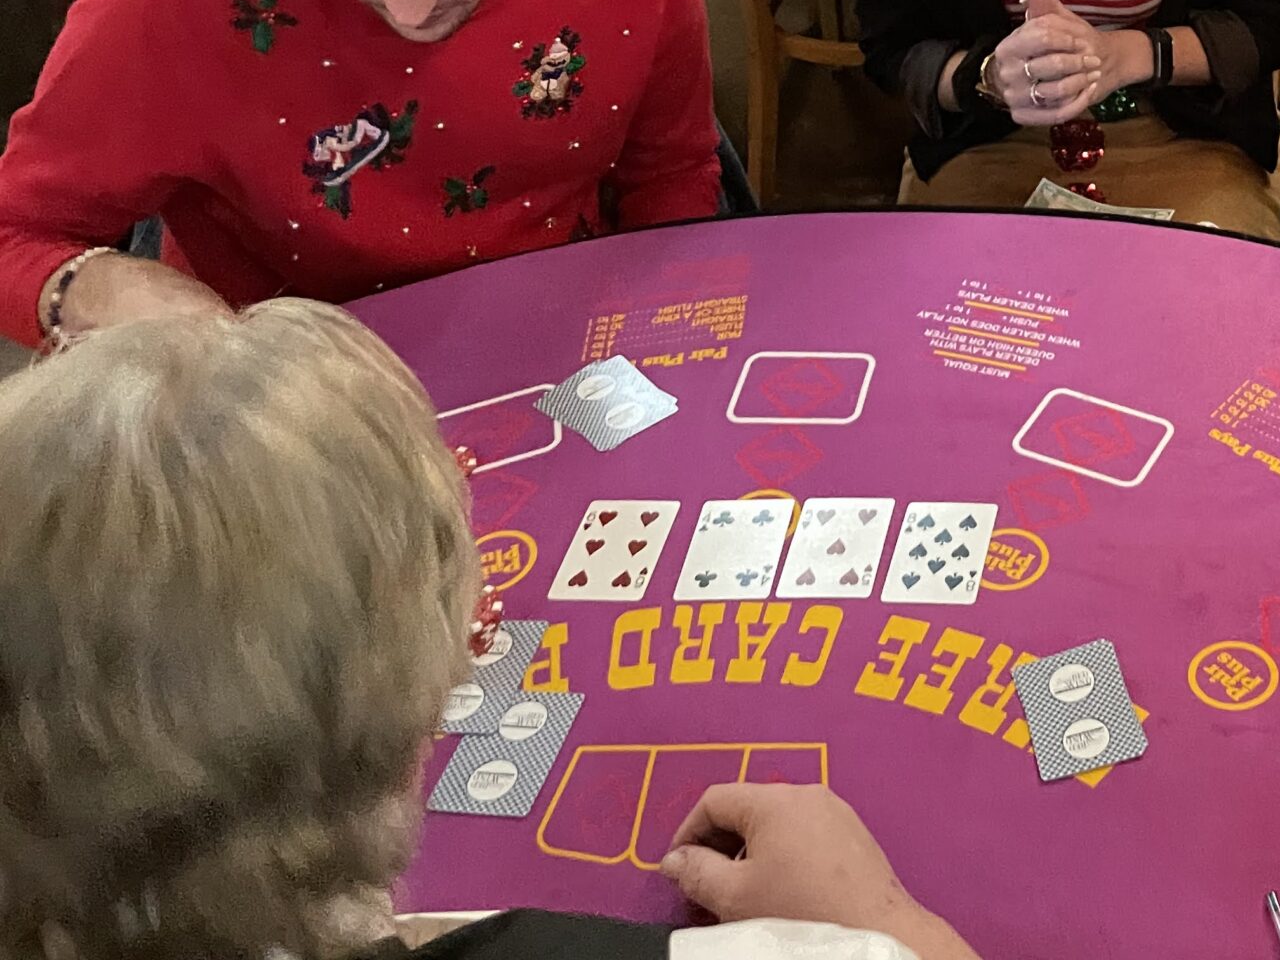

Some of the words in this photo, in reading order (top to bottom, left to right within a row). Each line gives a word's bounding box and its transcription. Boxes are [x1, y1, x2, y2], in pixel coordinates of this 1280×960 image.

[958, 289, 990, 302] PLAYS
[993, 296, 1035, 310] DEALER
[916, 309, 944, 321] PLAY
[1038, 304, 1068, 316] WHEN
[946, 315, 968, 326] NOT
[971, 320, 1000, 331] DOES
[1009, 316, 1039, 327] PUSH
[924, 328, 966, 342] BETTER
[1002, 325, 1045, 340] DEALER
[928, 337, 957, 349] WITH
[968, 336, 984, 345] OR
[986, 340, 1013, 351] HIGH
[1047, 335, 1080, 347] WHEN
[688, 346, 727, 360] Pair
[959, 343, 993, 357] PLAYS
[1016, 346, 1054, 359] QUEEN
[642, 352, 683, 366] Plus
[996, 351, 1039, 365] DEALER
[943, 358, 977, 372] EQUAL
[978, 366, 1010, 378] MUST
[1208, 428, 1251, 456] Pays
[607, 601, 845, 693] CARD
[1217, 652, 1264, 691] Plus
[1202, 663, 1251, 701] Pair
